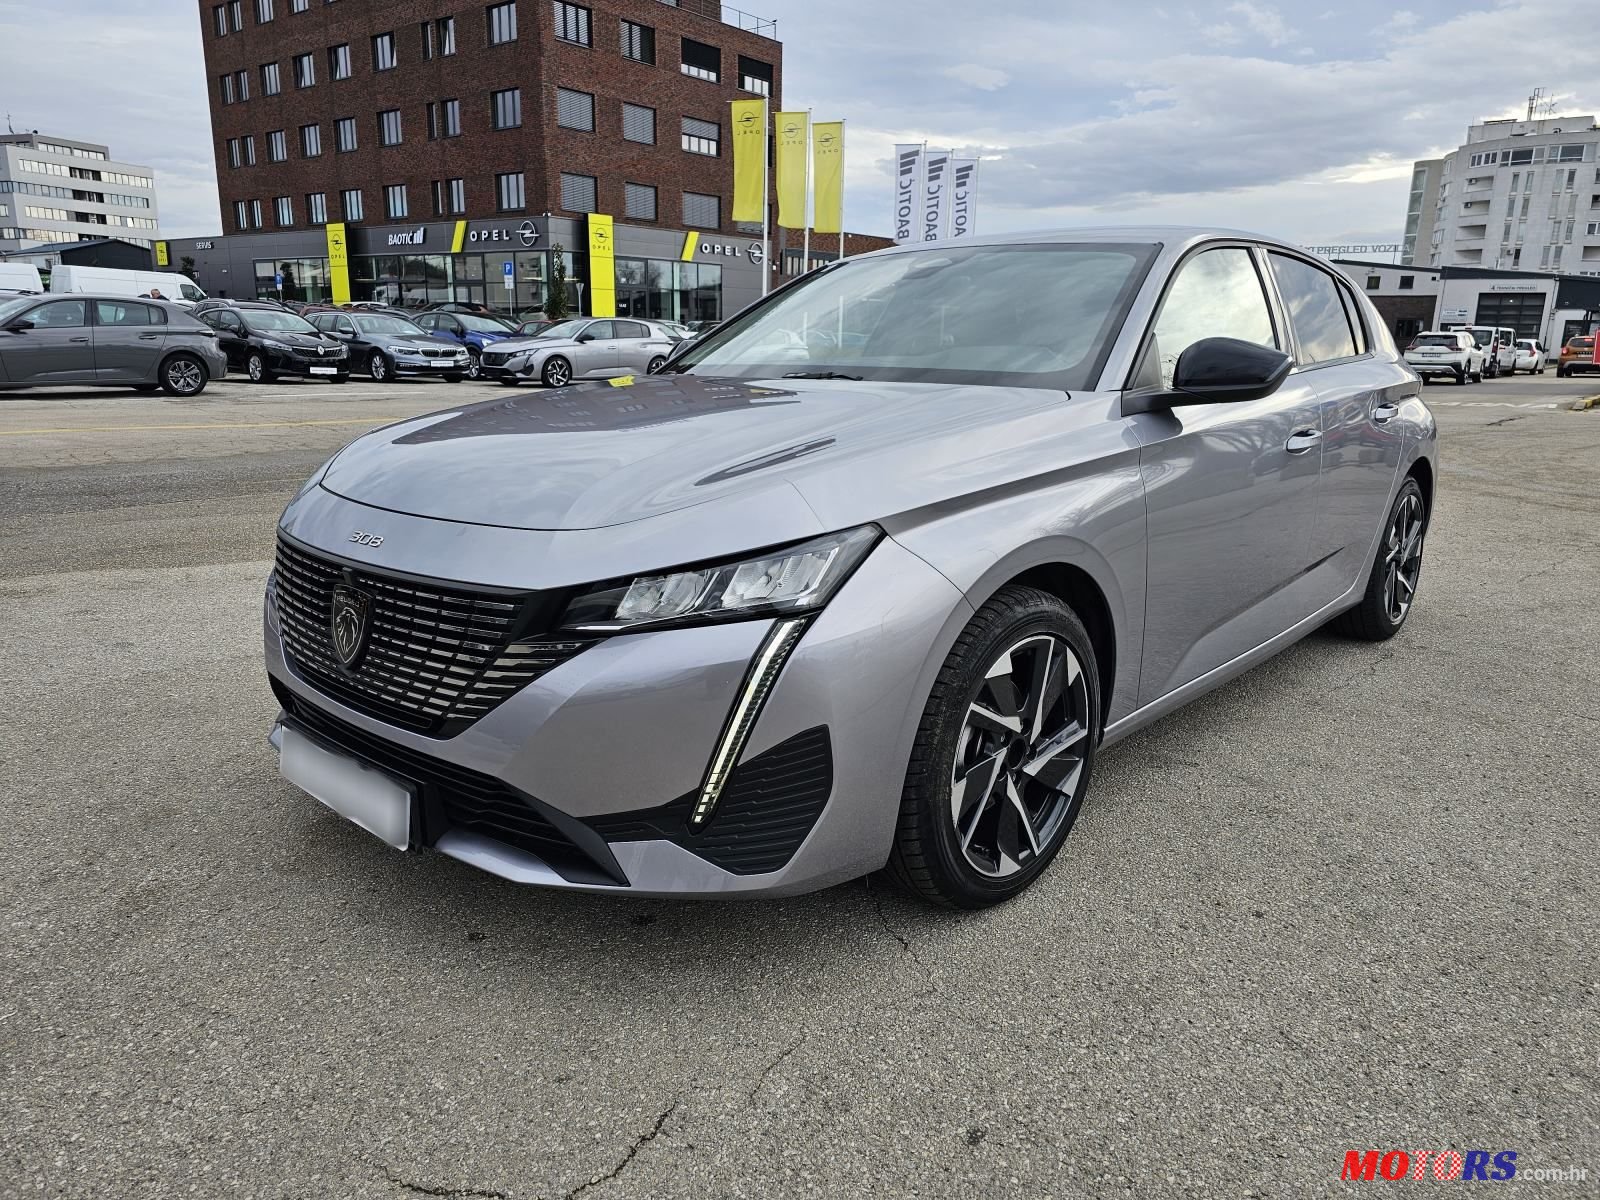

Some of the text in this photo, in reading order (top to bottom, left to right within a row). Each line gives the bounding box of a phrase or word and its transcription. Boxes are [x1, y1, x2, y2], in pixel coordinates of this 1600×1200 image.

[388, 230, 413, 246] BAOTIĆ
[470, 229, 510, 242] OPEL
[195, 241, 212, 250] SERVIS
[701, 243, 742, 257] OPEL
[1316, 245, 1368, 254] PREGLED
[1371, 244, 1410, 253] VOZILA
[348, 530, 385, 548] 308
